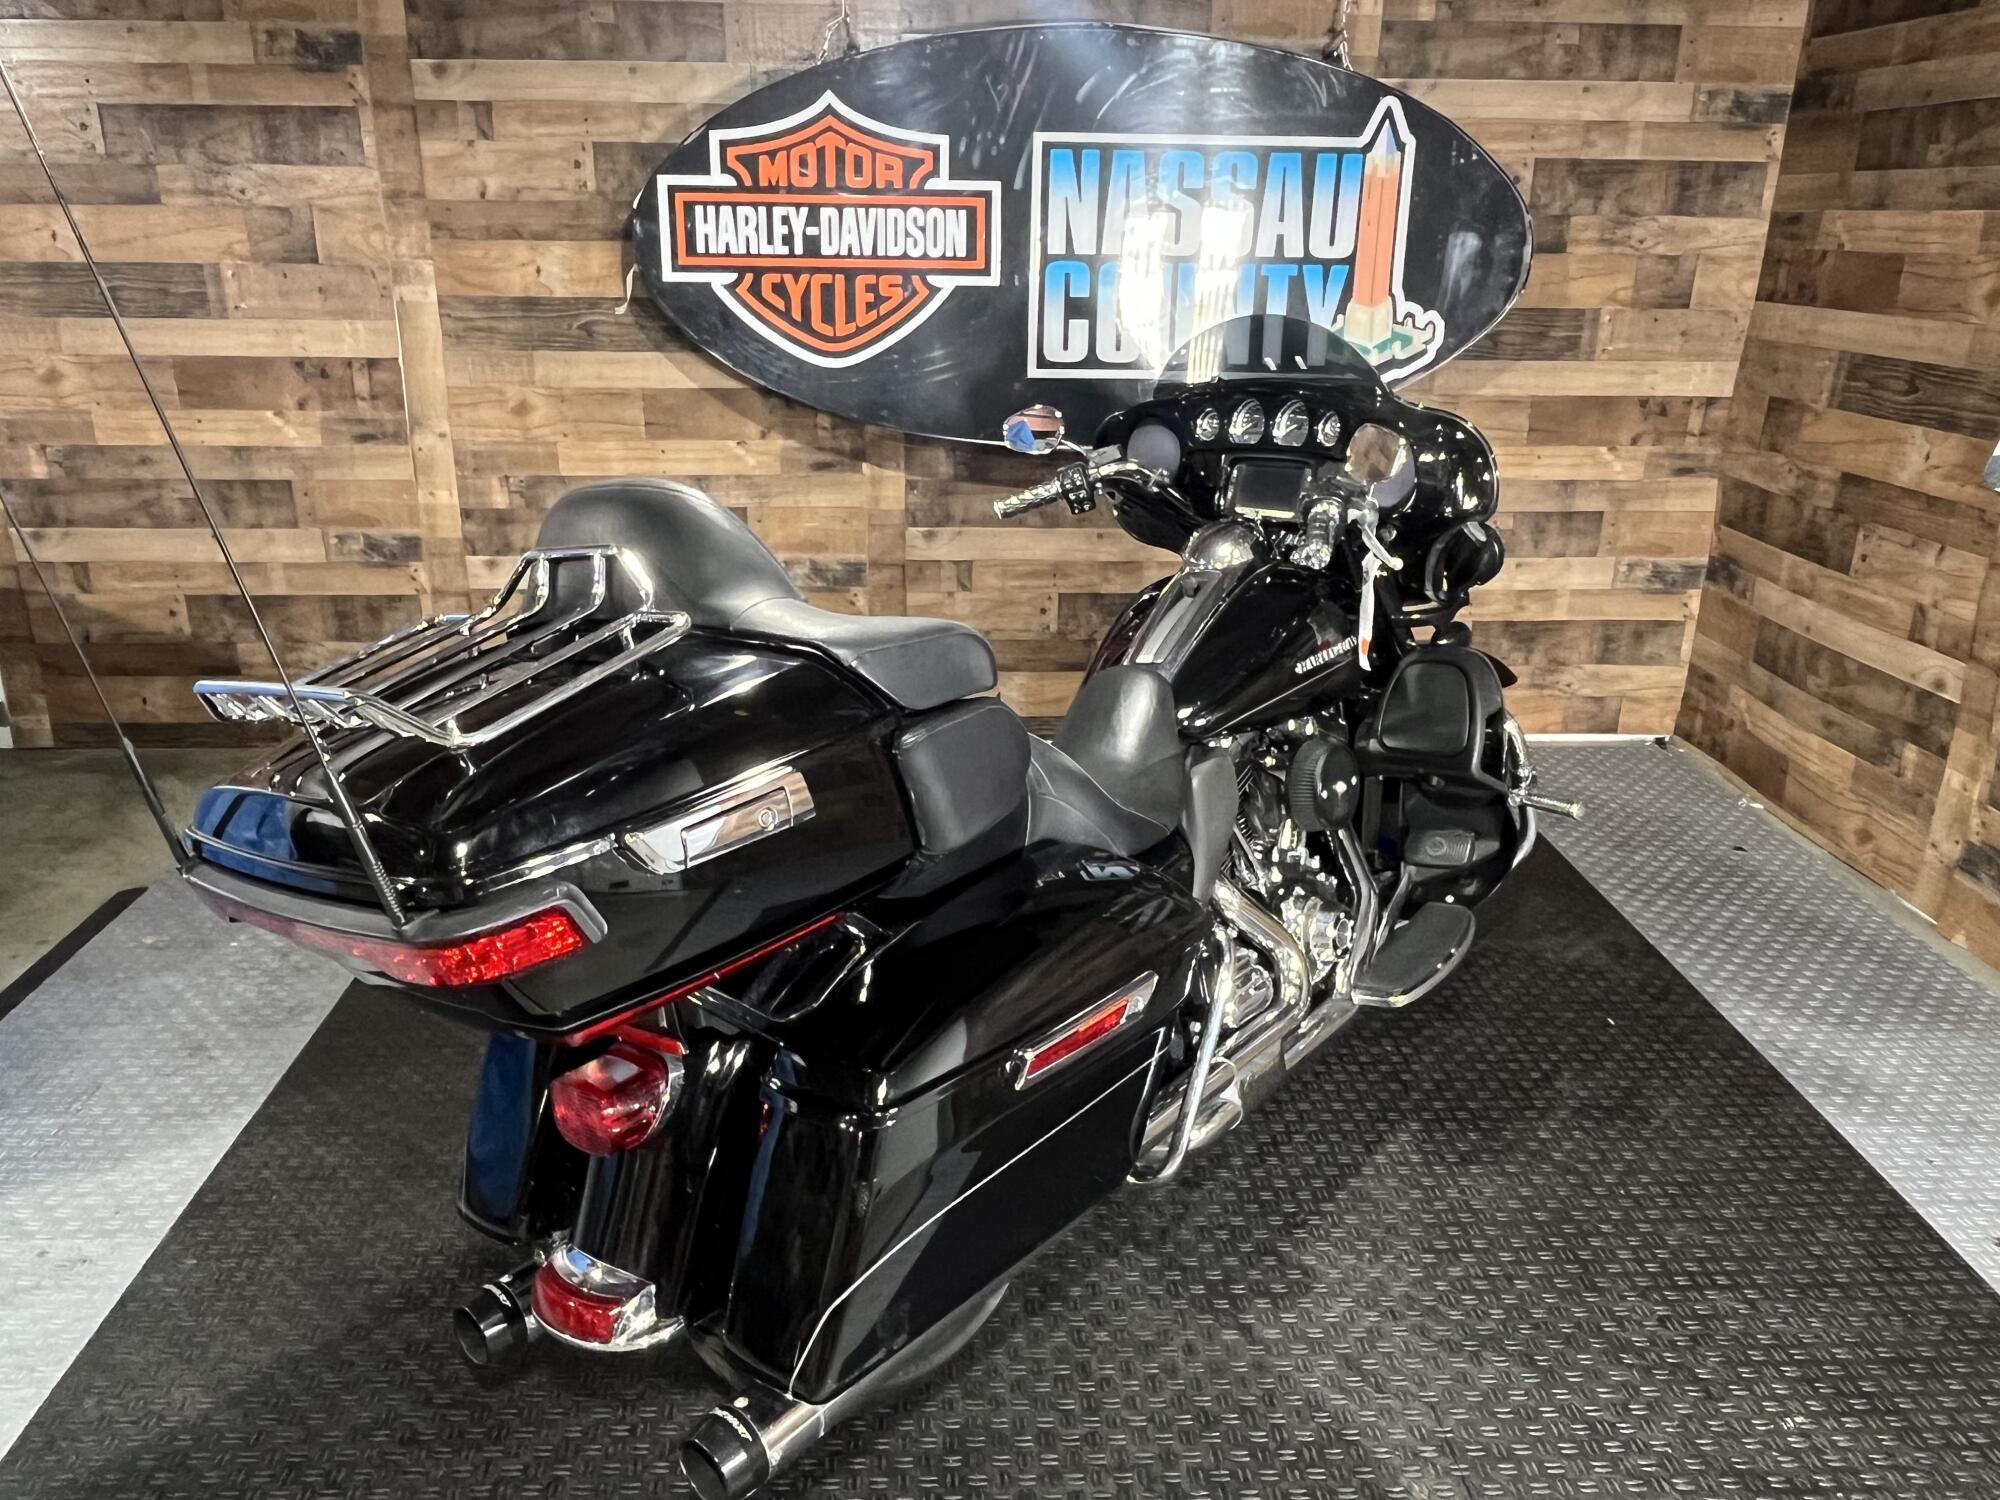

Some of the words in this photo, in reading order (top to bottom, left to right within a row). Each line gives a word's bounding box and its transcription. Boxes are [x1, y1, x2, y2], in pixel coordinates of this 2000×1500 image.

[758, 131, 903, 188] MOTOR
[694, 204, 967, 258] HARLEY-DAVIDSON
[1047, 148, 1364, 259] NASSAU
[761, 273, 904, 337] CYCLES
